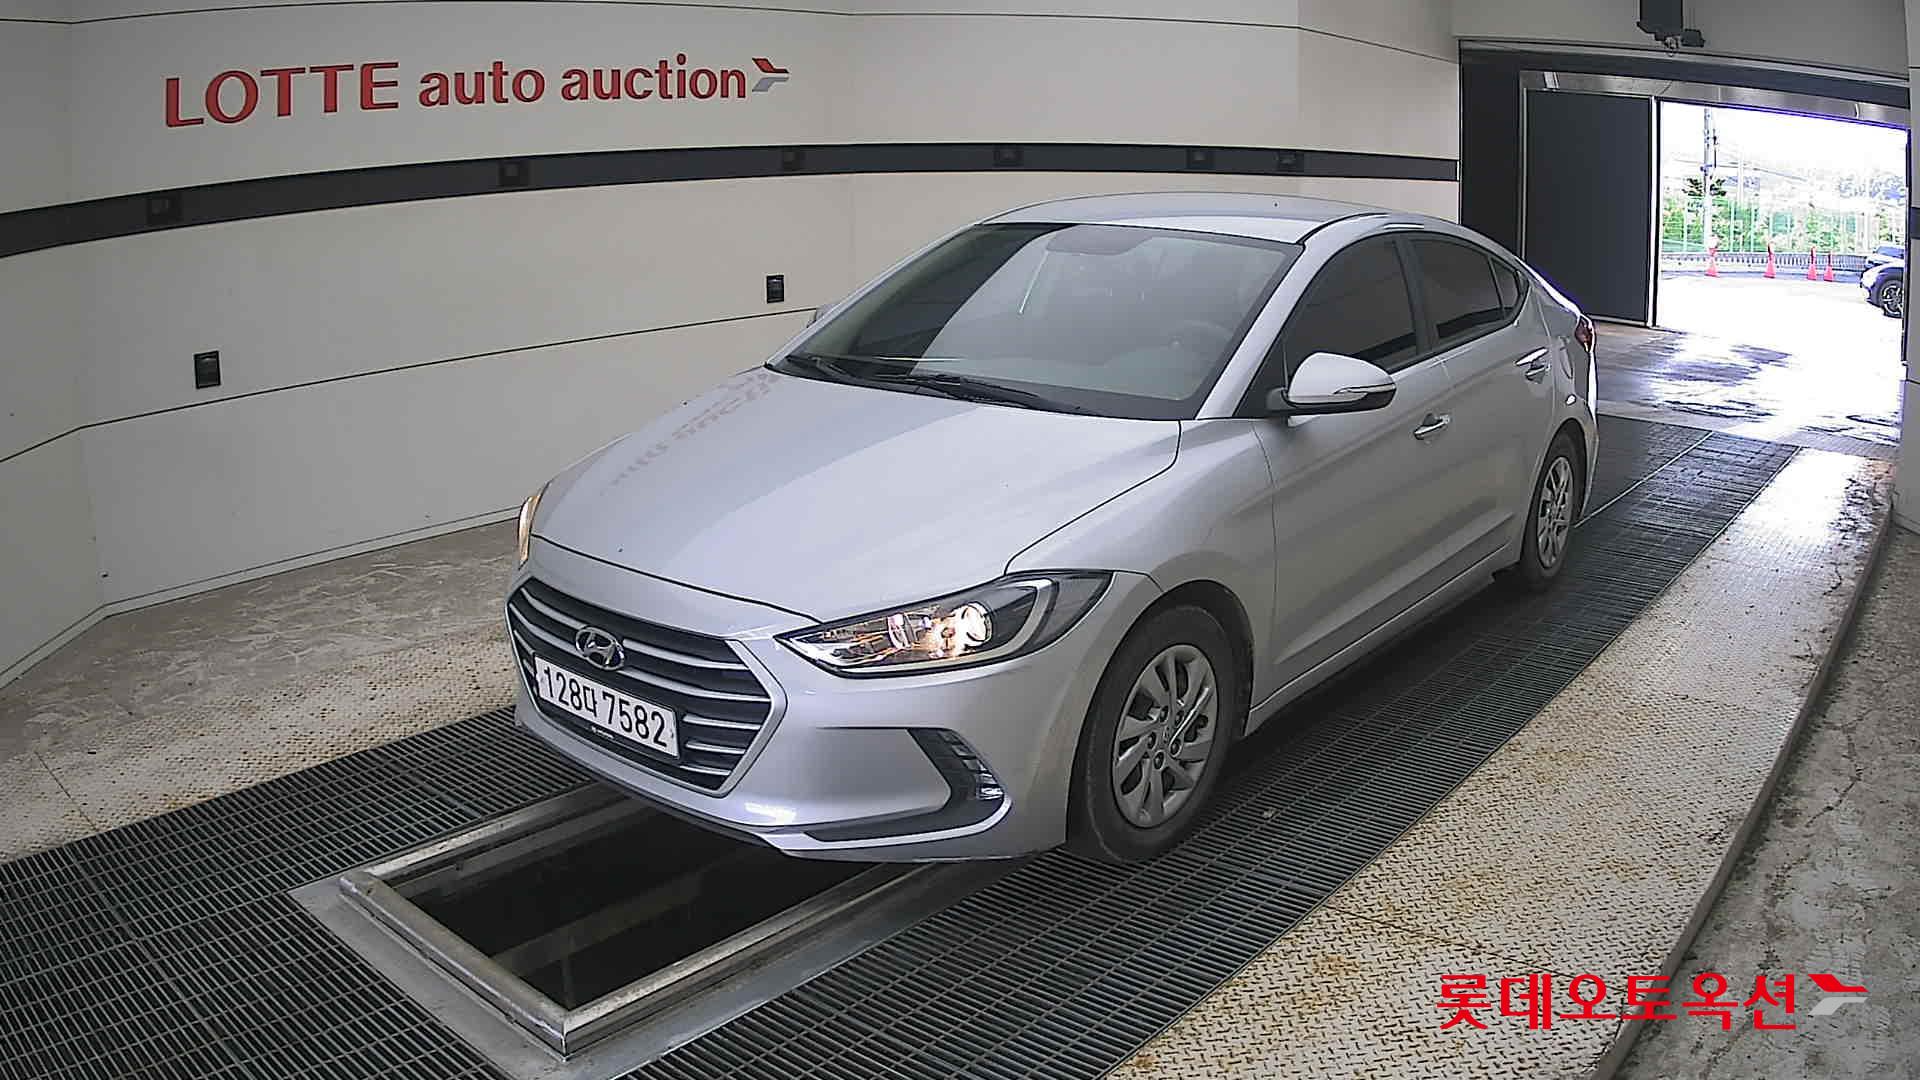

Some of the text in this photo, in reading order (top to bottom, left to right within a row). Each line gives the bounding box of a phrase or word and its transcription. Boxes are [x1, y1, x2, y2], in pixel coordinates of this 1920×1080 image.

[166, 53, 747, 127] LOTTE auto auction
[602, 691, 668, 748] 7582
